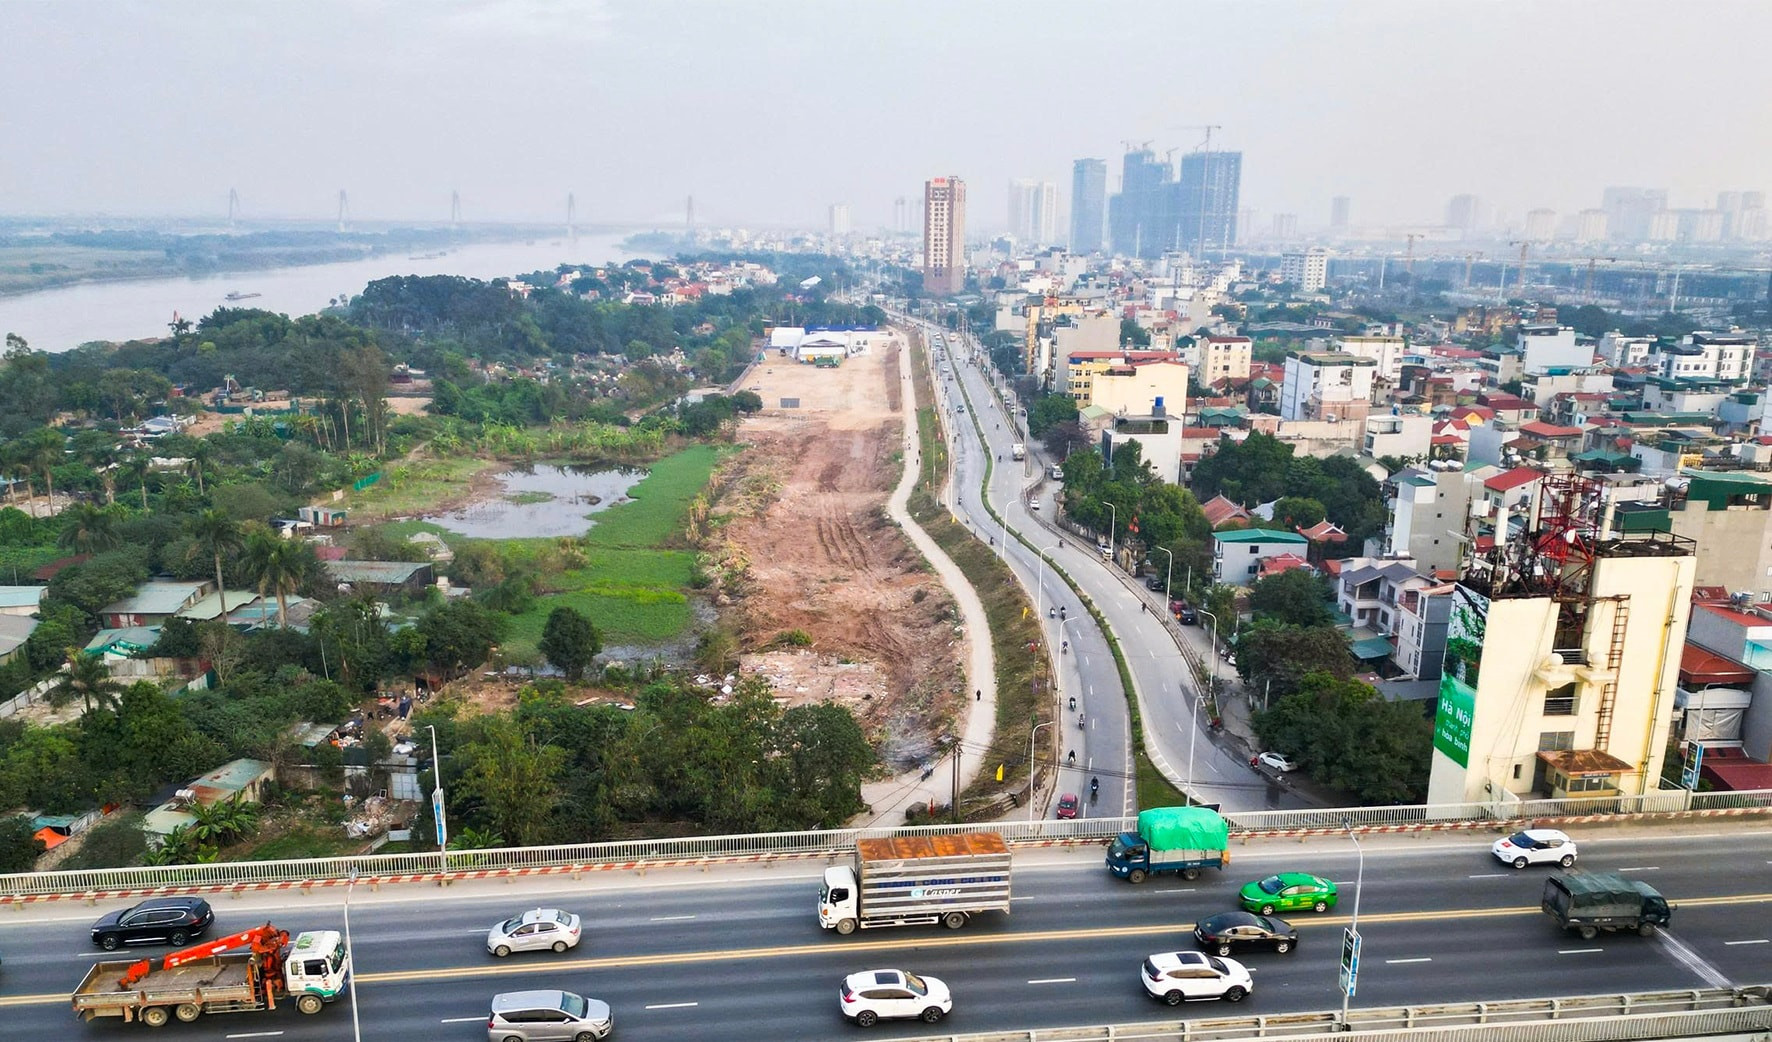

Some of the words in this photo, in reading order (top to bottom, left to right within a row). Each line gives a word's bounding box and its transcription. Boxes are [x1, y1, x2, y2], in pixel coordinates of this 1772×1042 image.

[1442, 698, 1453, 715] Hà
[1456, 707, 1471, 728] Nội
[924, 887, 961, 899] Casper
